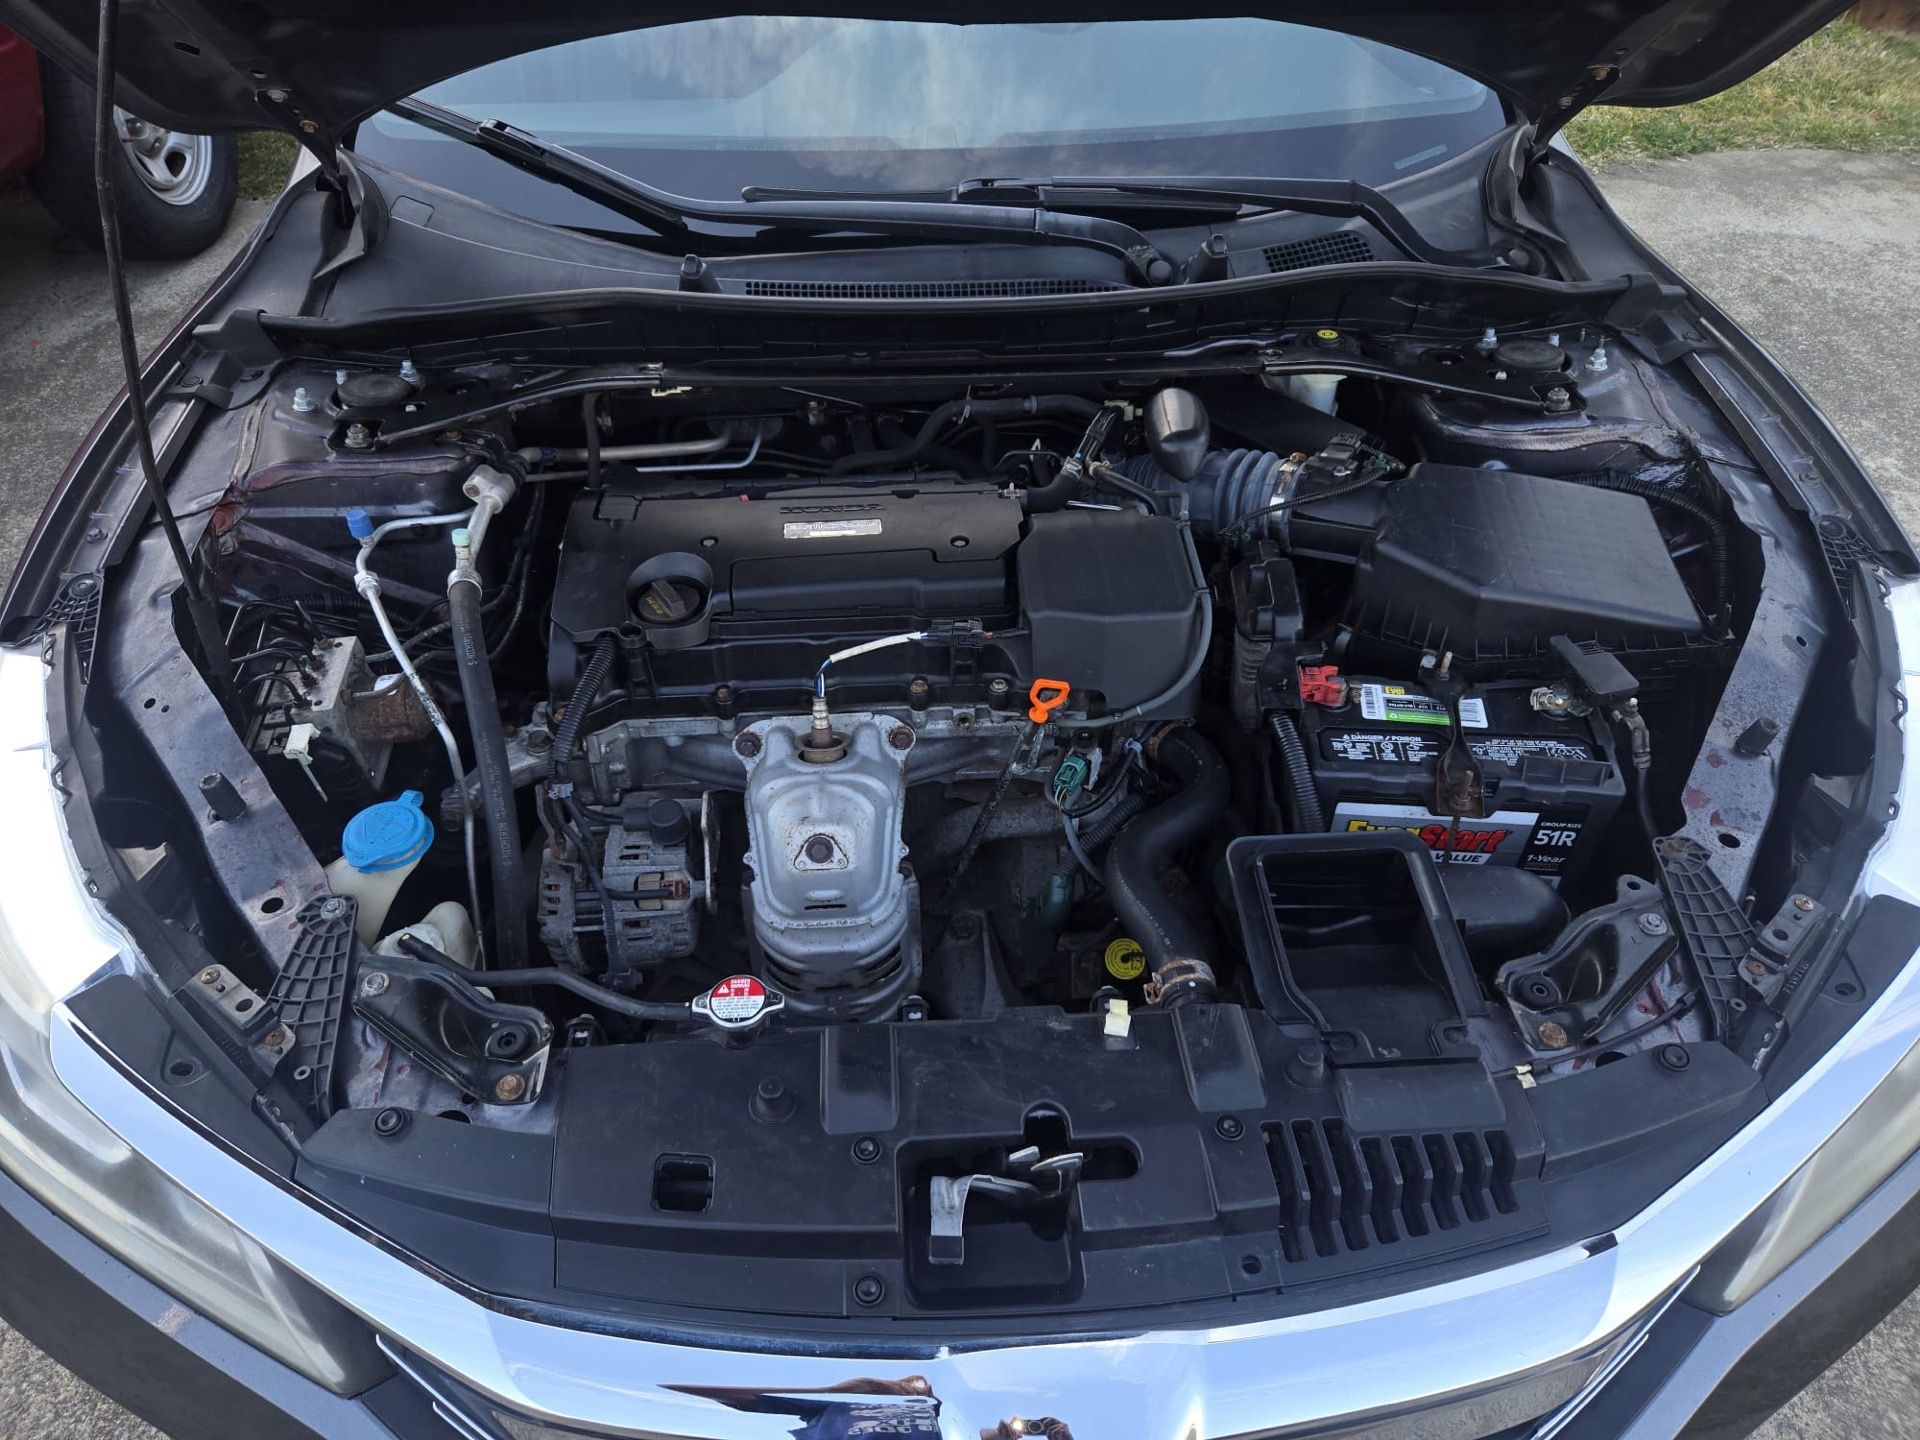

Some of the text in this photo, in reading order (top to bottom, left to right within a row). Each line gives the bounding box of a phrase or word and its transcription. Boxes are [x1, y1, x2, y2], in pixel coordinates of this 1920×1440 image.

[779, 504, 886, 514] HONDA
[1533, 829, 1577, 847] 51R
[1527, 854, 1567, 863] 1-Year
